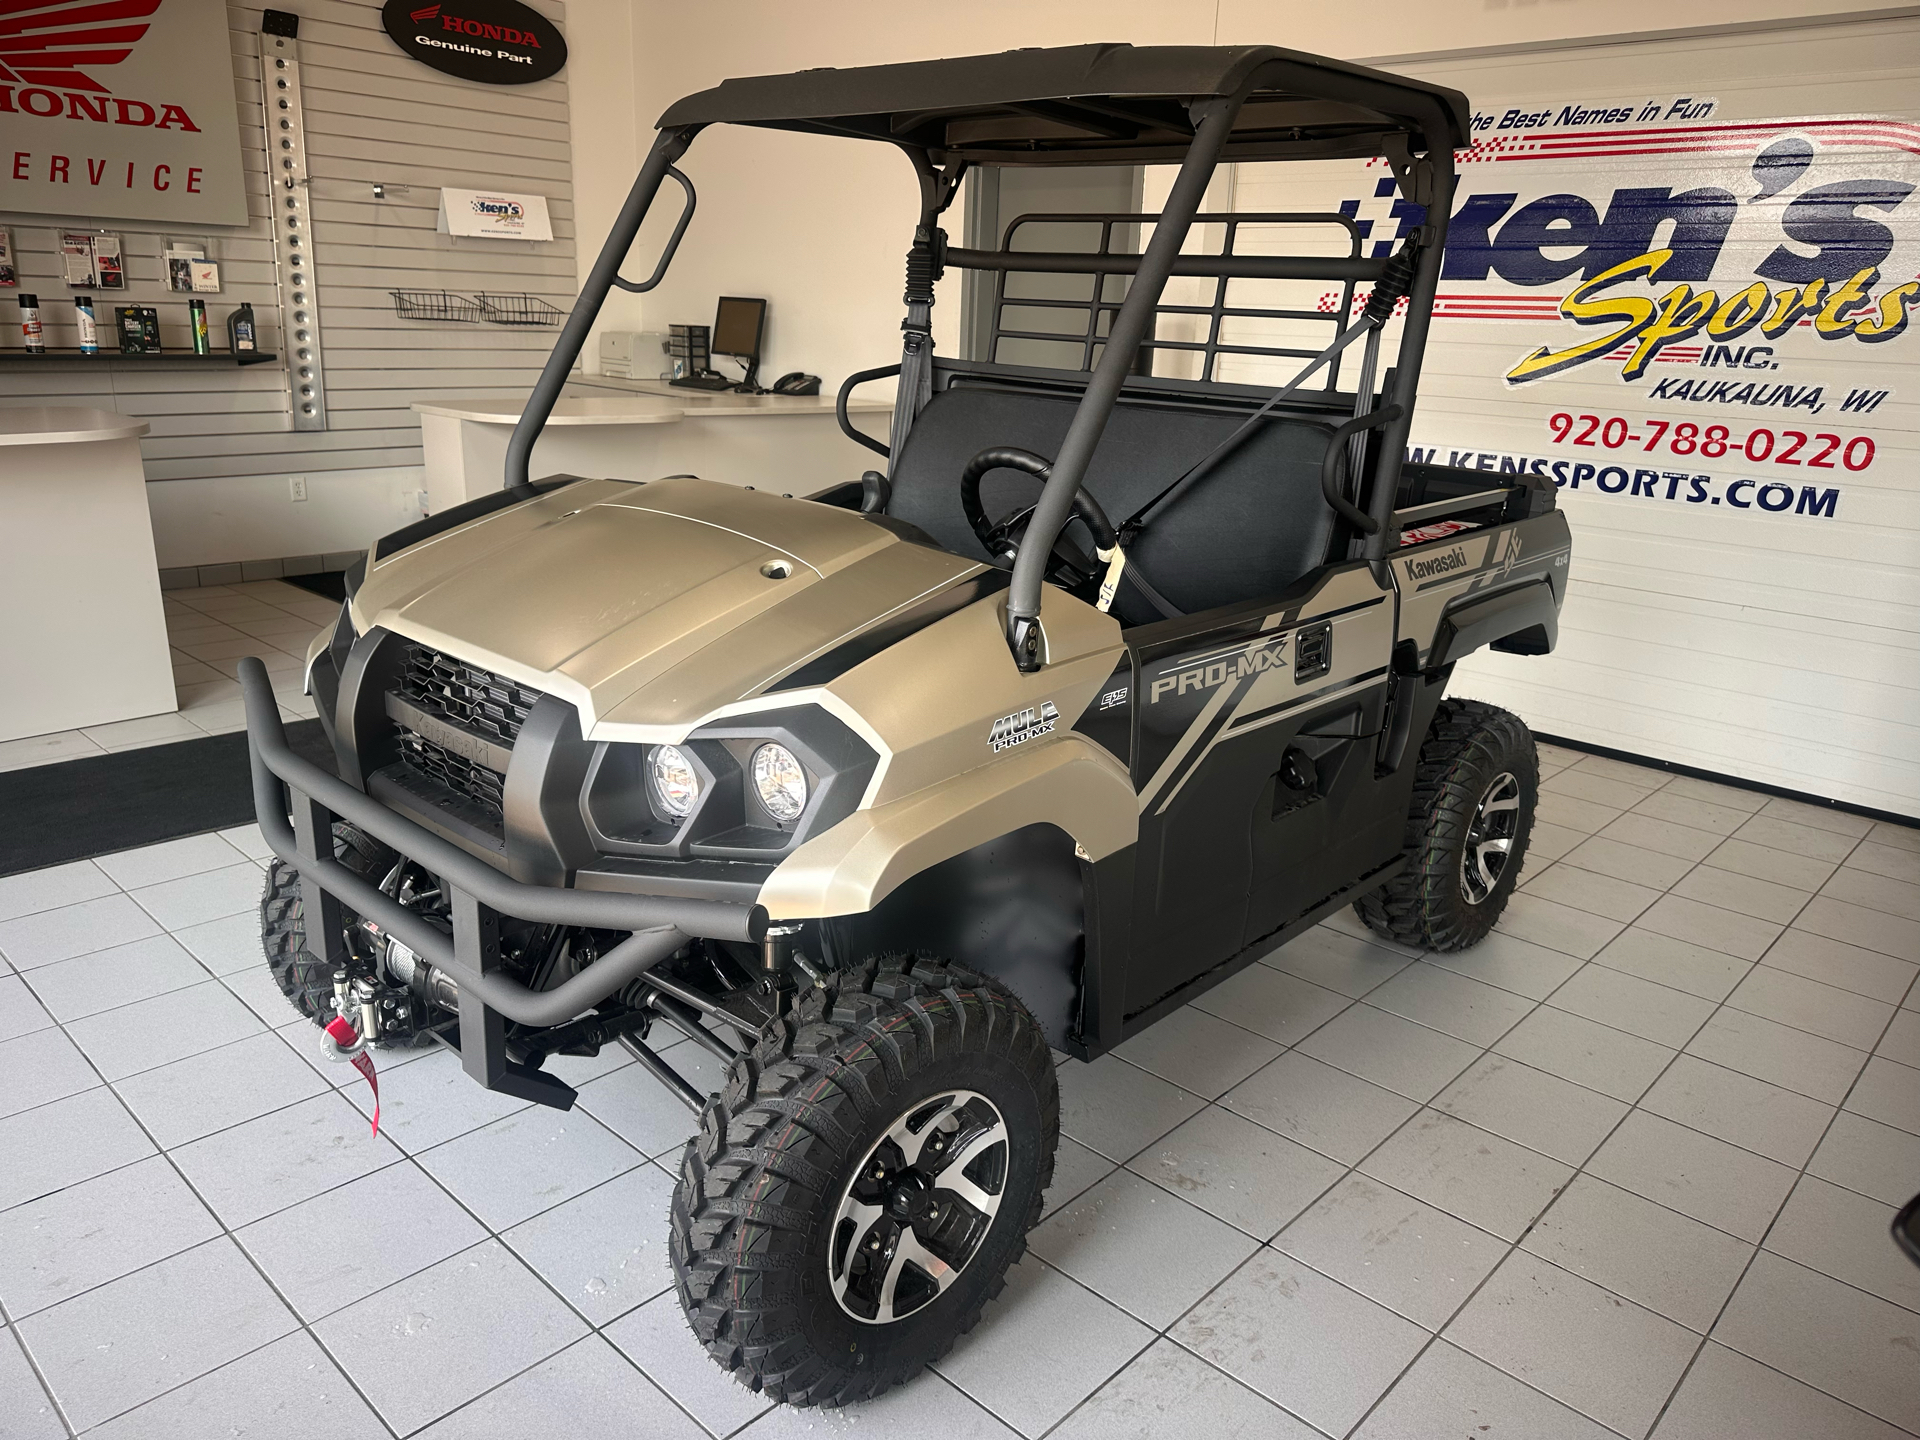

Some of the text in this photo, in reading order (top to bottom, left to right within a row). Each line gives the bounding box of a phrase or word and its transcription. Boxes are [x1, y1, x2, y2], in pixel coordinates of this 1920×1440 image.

[441, 14, 542, 48] HONDA
[414, 35, 533, 65] Genuine Part
[1496, 109, 1551, 129] Best
[1553, 105, 1634, 126] Names
[1636, 100, 1662, 122] in
[1663, 98, 1714, 120] Fun
[480, 201, 520, 215] ken's
[1506, 249, 1920, 386] Sports
[1700, 345, 1780, 370] INC.
[1648, 377, 1890, 415] KAUKAUNA, WI
[1549, 412, 1876, 472] 920-788-0220
[1404, 546, 1467, 581] Kawasaki
[1150, 640, 1288, 705] PRO-MX
[1101, 687, 1128, 706] EPS
[413, 709, 489, 766] Kawasaki
[987, 700, 1061, 745] MULE
[993, 721, 1056, 753] PRO-MX
